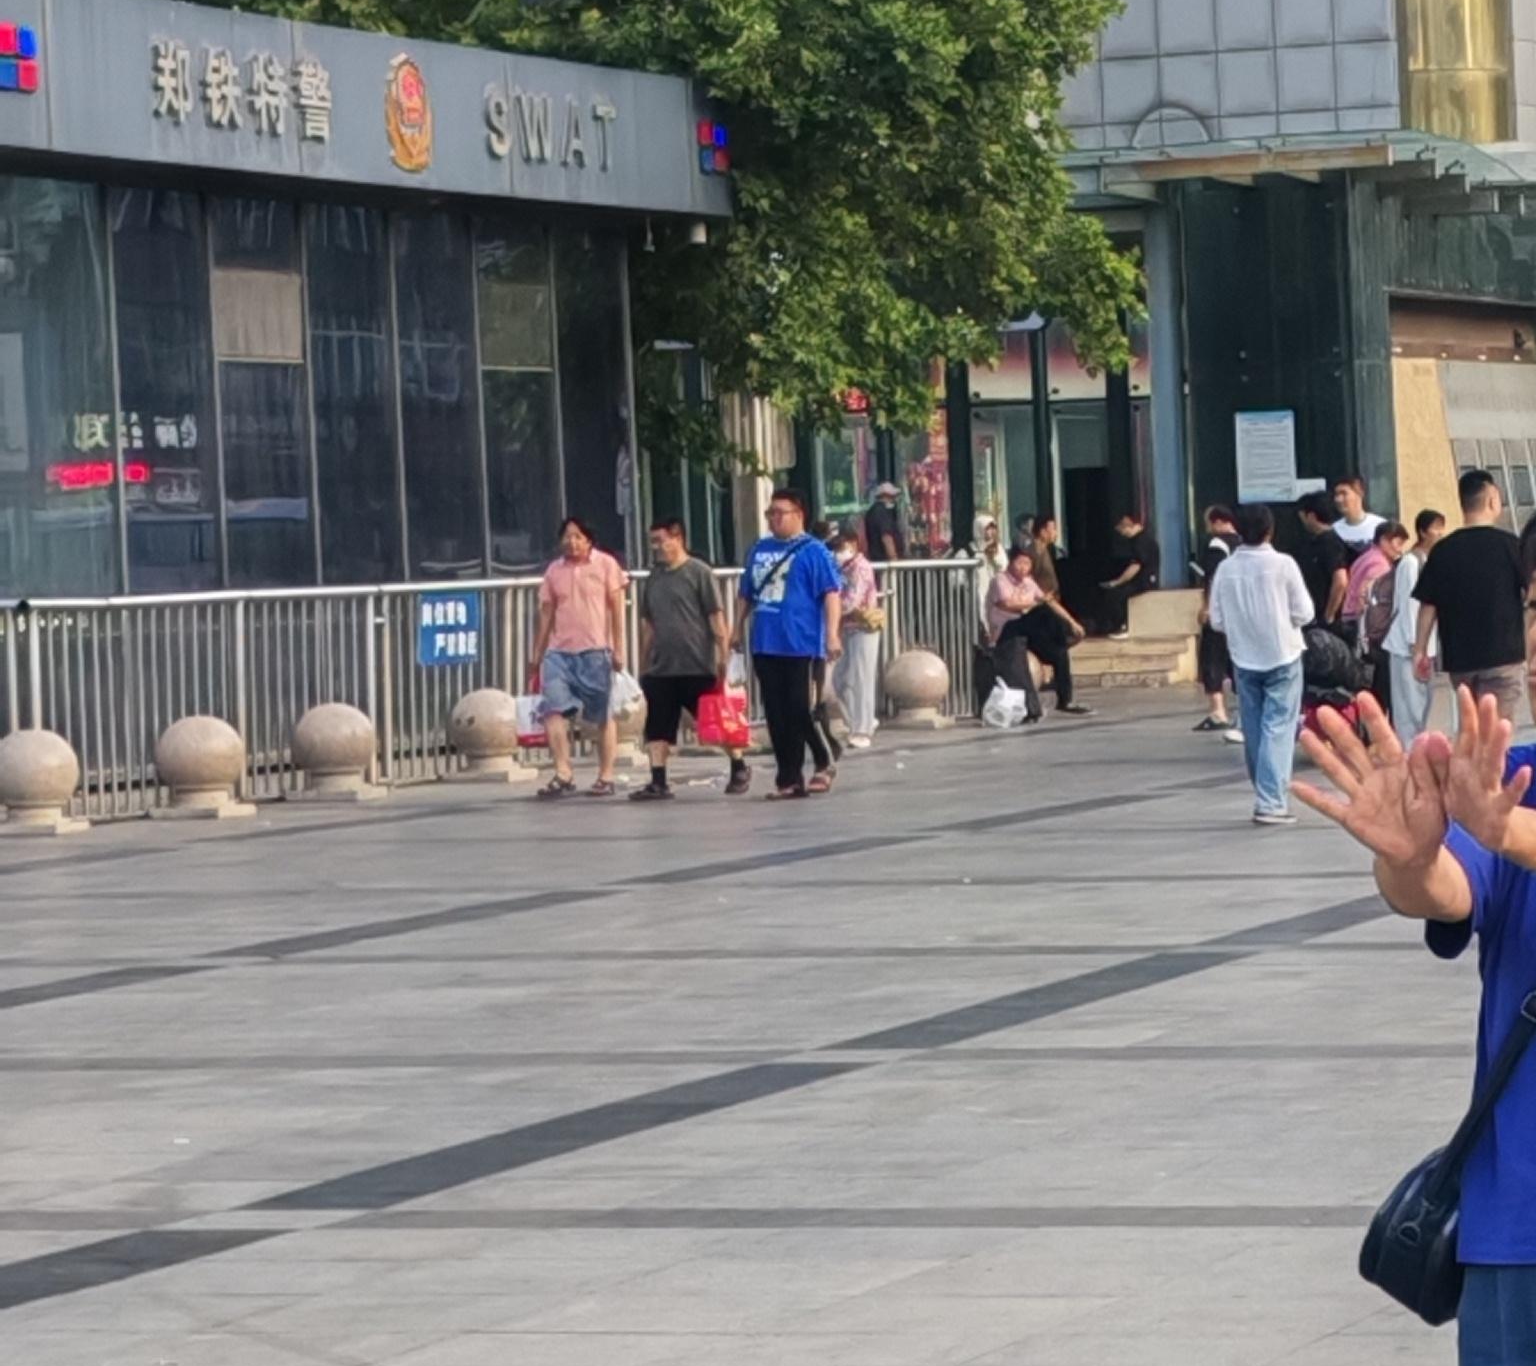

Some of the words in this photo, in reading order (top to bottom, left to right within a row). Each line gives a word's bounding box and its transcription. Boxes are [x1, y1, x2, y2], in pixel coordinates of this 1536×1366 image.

[152, 40, 333, 144] 郑铁特警
[485, 83, 616, 172] SWAT
